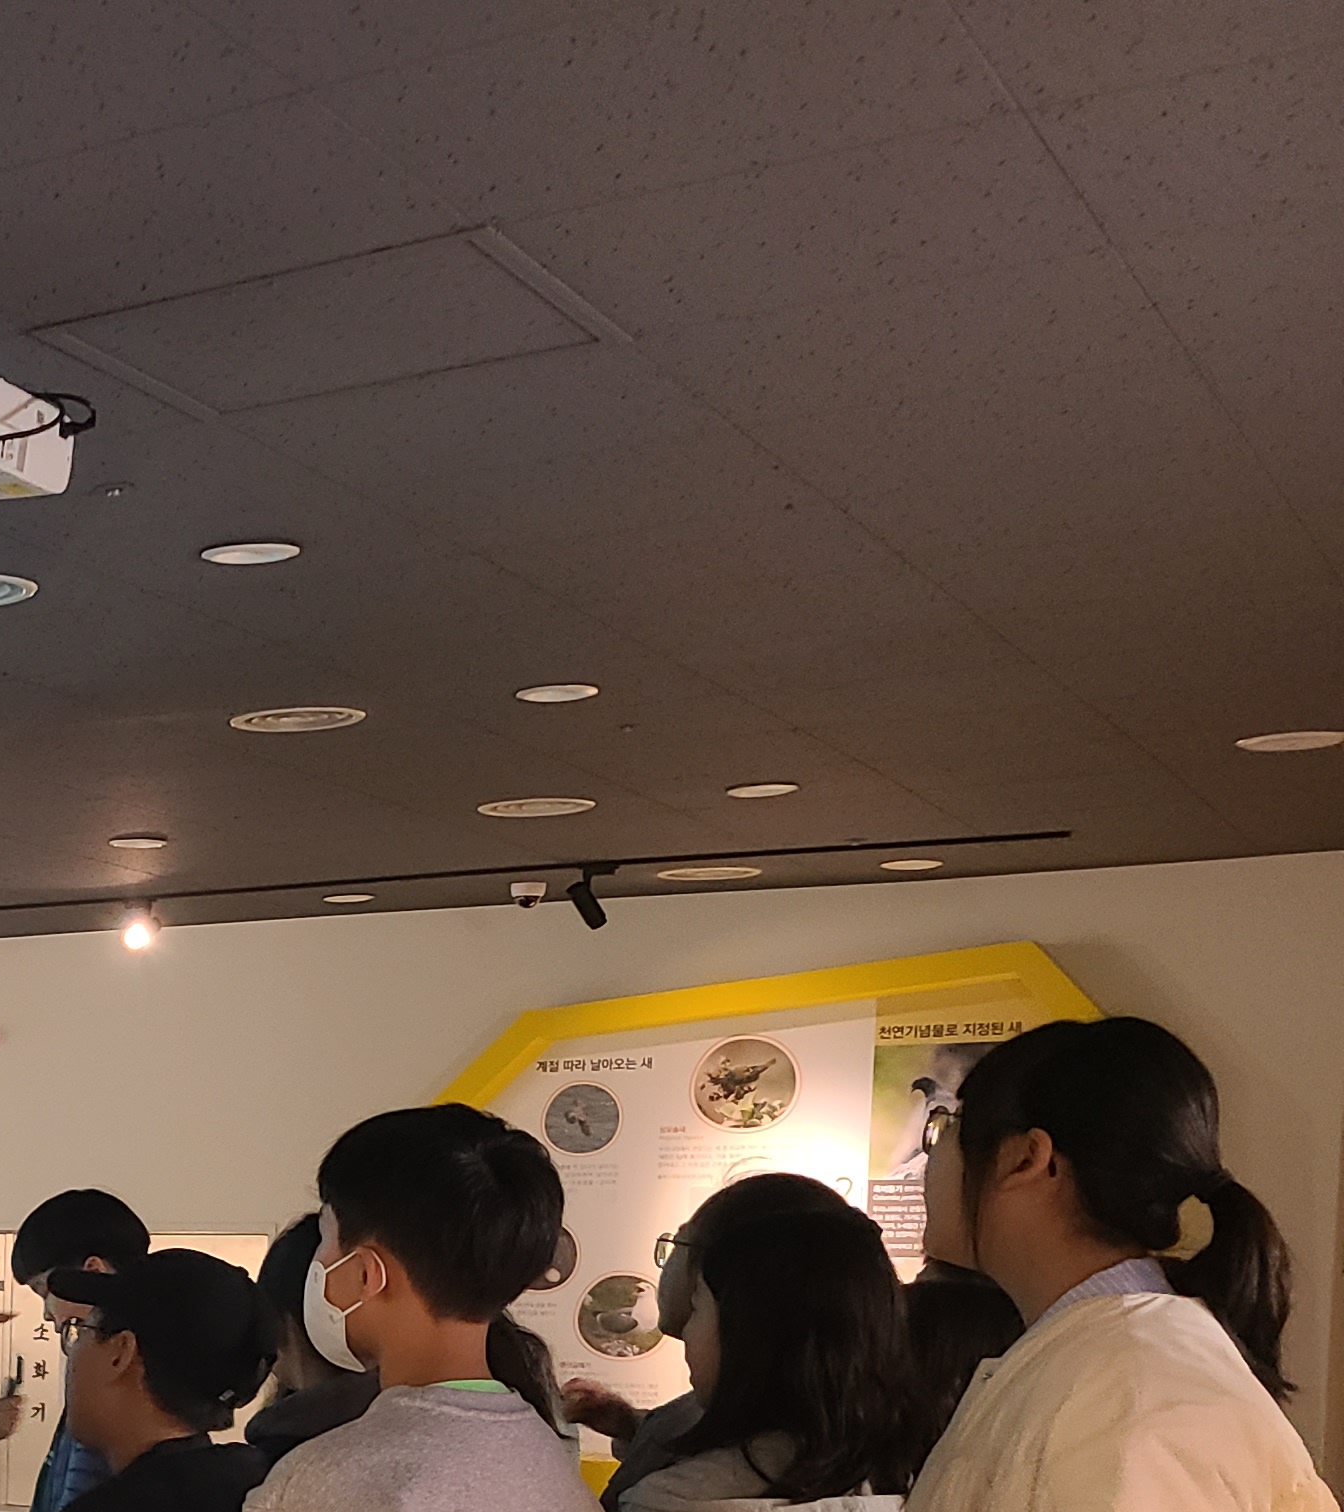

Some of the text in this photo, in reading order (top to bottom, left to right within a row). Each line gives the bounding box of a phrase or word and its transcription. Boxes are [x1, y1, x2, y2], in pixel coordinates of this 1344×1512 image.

[878, 1020, 1022, 1039] 천연기념물로 지정된 새
[536, 1056, 653, 1072] 계절 따라 날아오는 새
[30, 1323, 50, 1422] 소화기
